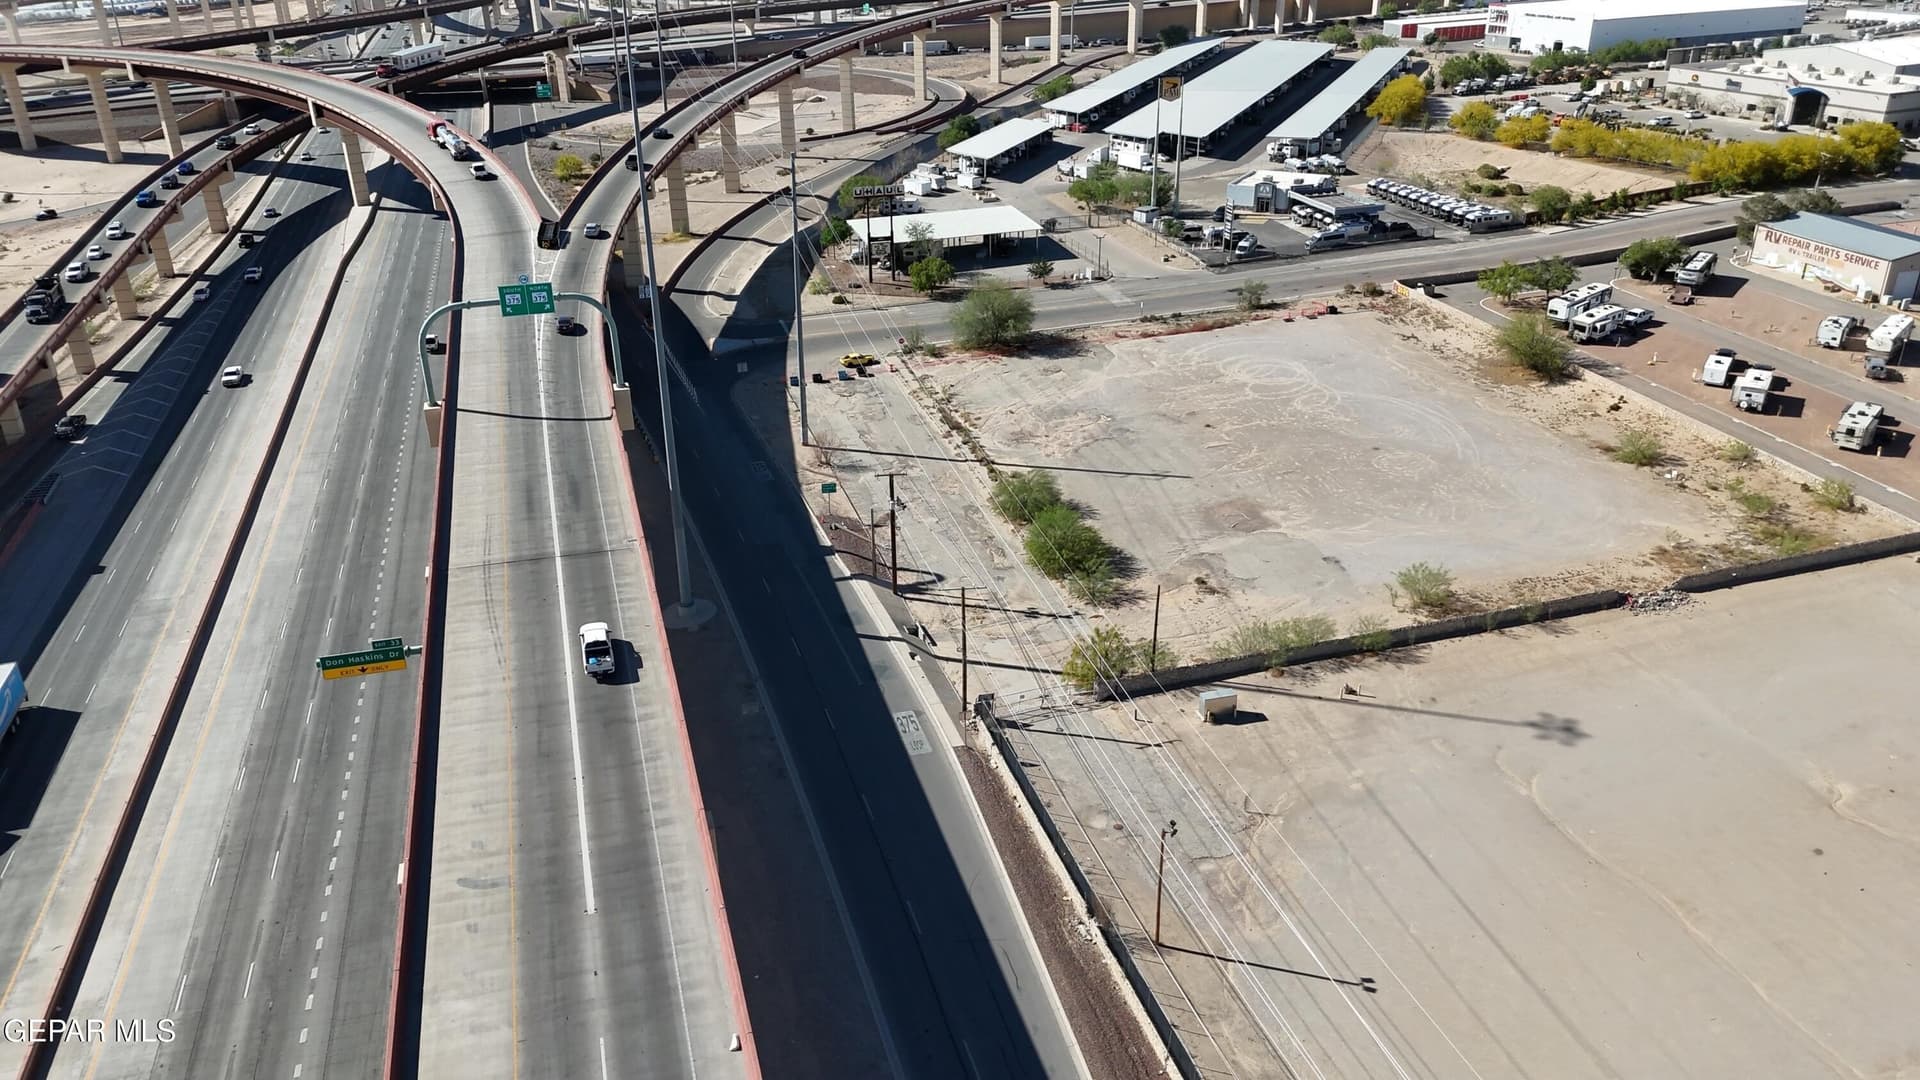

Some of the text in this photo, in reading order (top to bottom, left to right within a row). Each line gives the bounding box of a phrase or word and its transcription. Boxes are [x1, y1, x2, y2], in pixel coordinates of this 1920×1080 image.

[1764, 229, 1783, 244] RV
[1782, 235, 1811, 251] REPAIR
[1814, 244, 1841, 259] PARTS
[1843, 253, 1881, 270] SERVICE
[325, 650, 400, 666] Don Haskins Dr
[896, 715, 919, 734] 375
